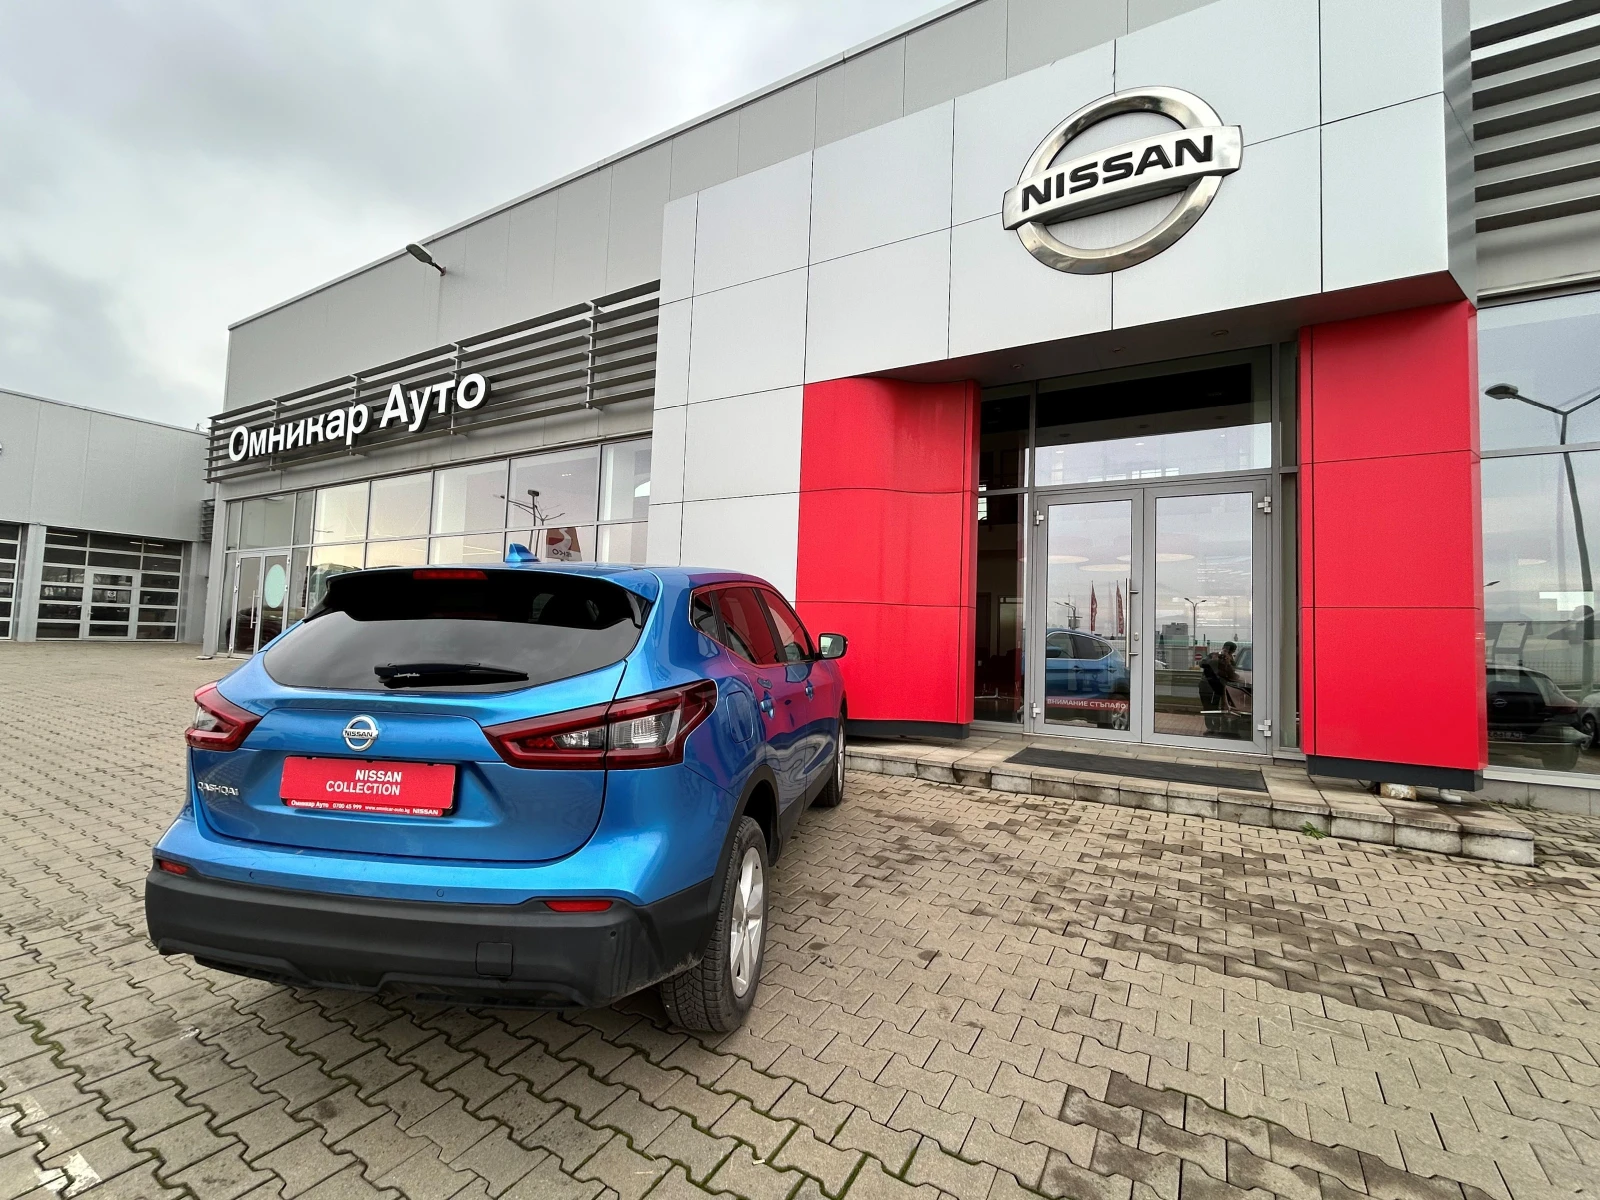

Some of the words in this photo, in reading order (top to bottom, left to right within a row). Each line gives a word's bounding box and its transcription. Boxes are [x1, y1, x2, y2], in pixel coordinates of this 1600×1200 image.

[1022, 134, 1214, 213] NISSAN
[228, 403, 371, 462] Омникар
[379, 372, 488, 433] Ауто
[1047, 698, 1088, 707] ВНИМАНИЕ
[355, 769, 402, 783] NISSAN
[198, 781, 239, 796] QASHQAI
[326, 780, 401, 796] COLLECTION
[316, 801, 329, 809] Ауто
